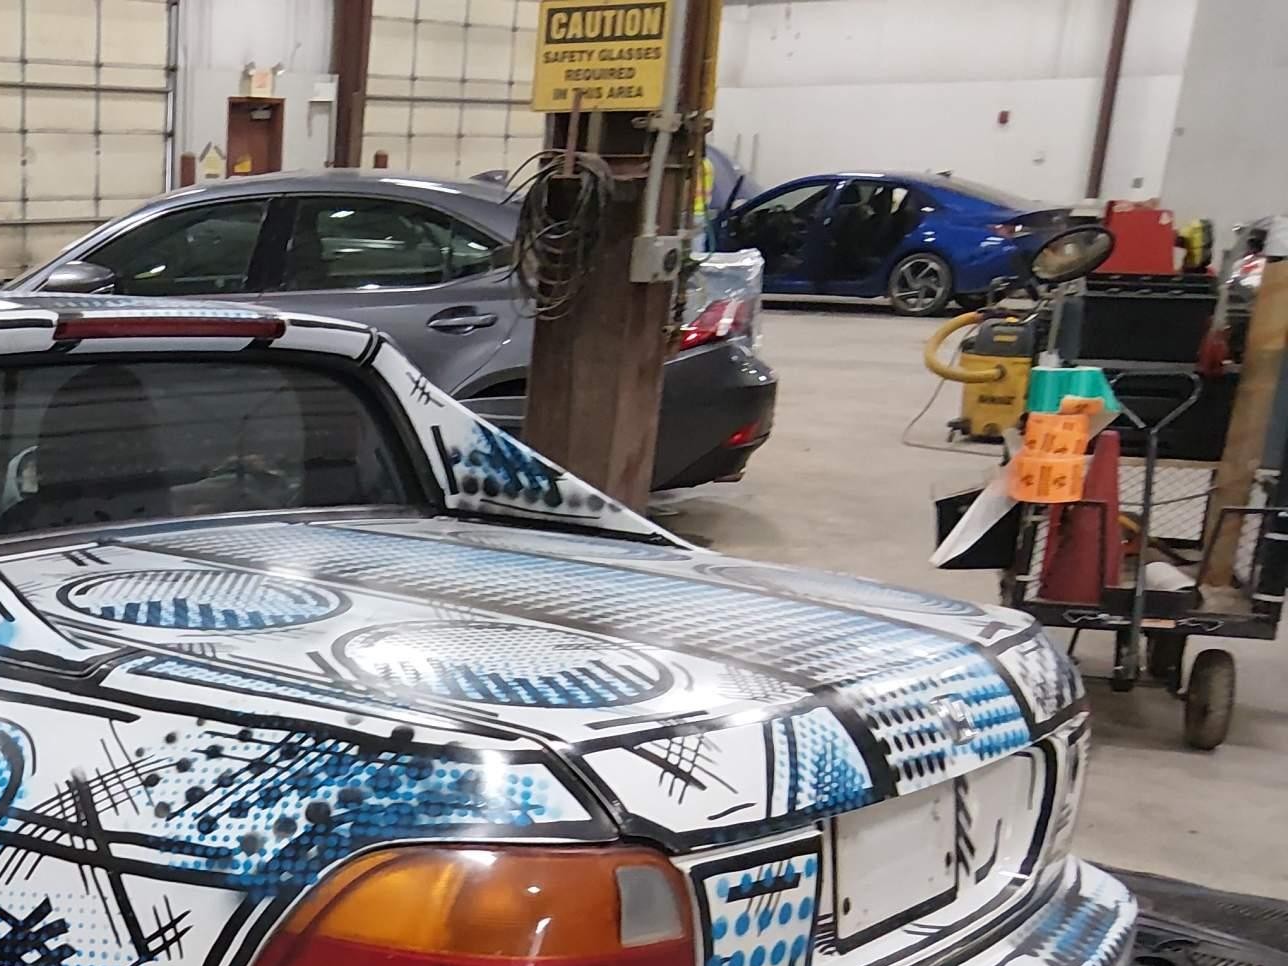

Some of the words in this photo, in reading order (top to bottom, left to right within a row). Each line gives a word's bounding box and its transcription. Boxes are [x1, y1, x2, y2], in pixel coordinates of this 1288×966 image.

[550, 8, 662, 39] CAUTION
[543, 50, 594, 63] SAFETY
[598, 47, 662, 61] GLASSES
[565, 67, 636, 80] REQUIRED
[553, 88, 568, 100] IN
[607, 86, 643, 98] AREA
